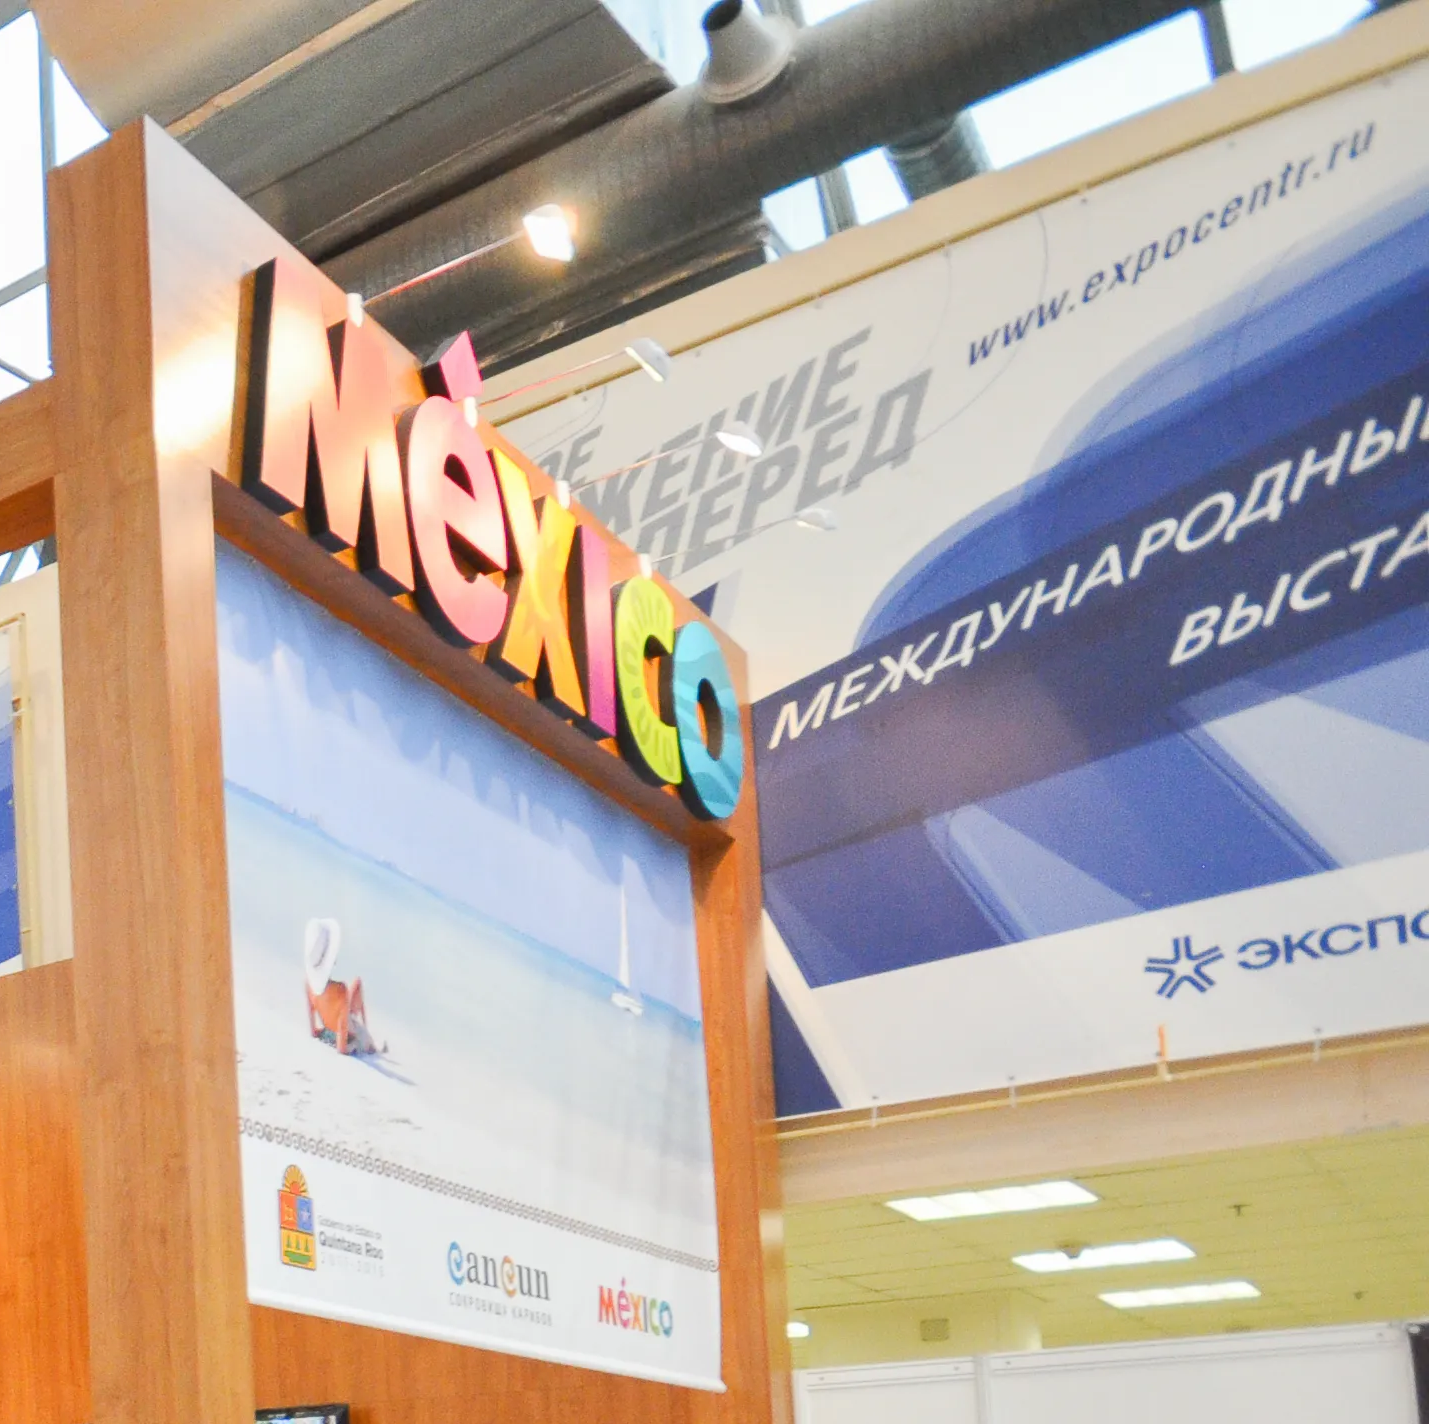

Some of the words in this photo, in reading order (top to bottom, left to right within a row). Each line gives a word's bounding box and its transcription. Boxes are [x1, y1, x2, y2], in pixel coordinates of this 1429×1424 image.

[968, 122, 1377, 367] www.expocentr.ru
[768, 395, 1429, 750] МЕЖДУНАРОДНЫ
[319, 1231, 362, 1255] Quintana
[365, 1242, 384, 1260] Roo
